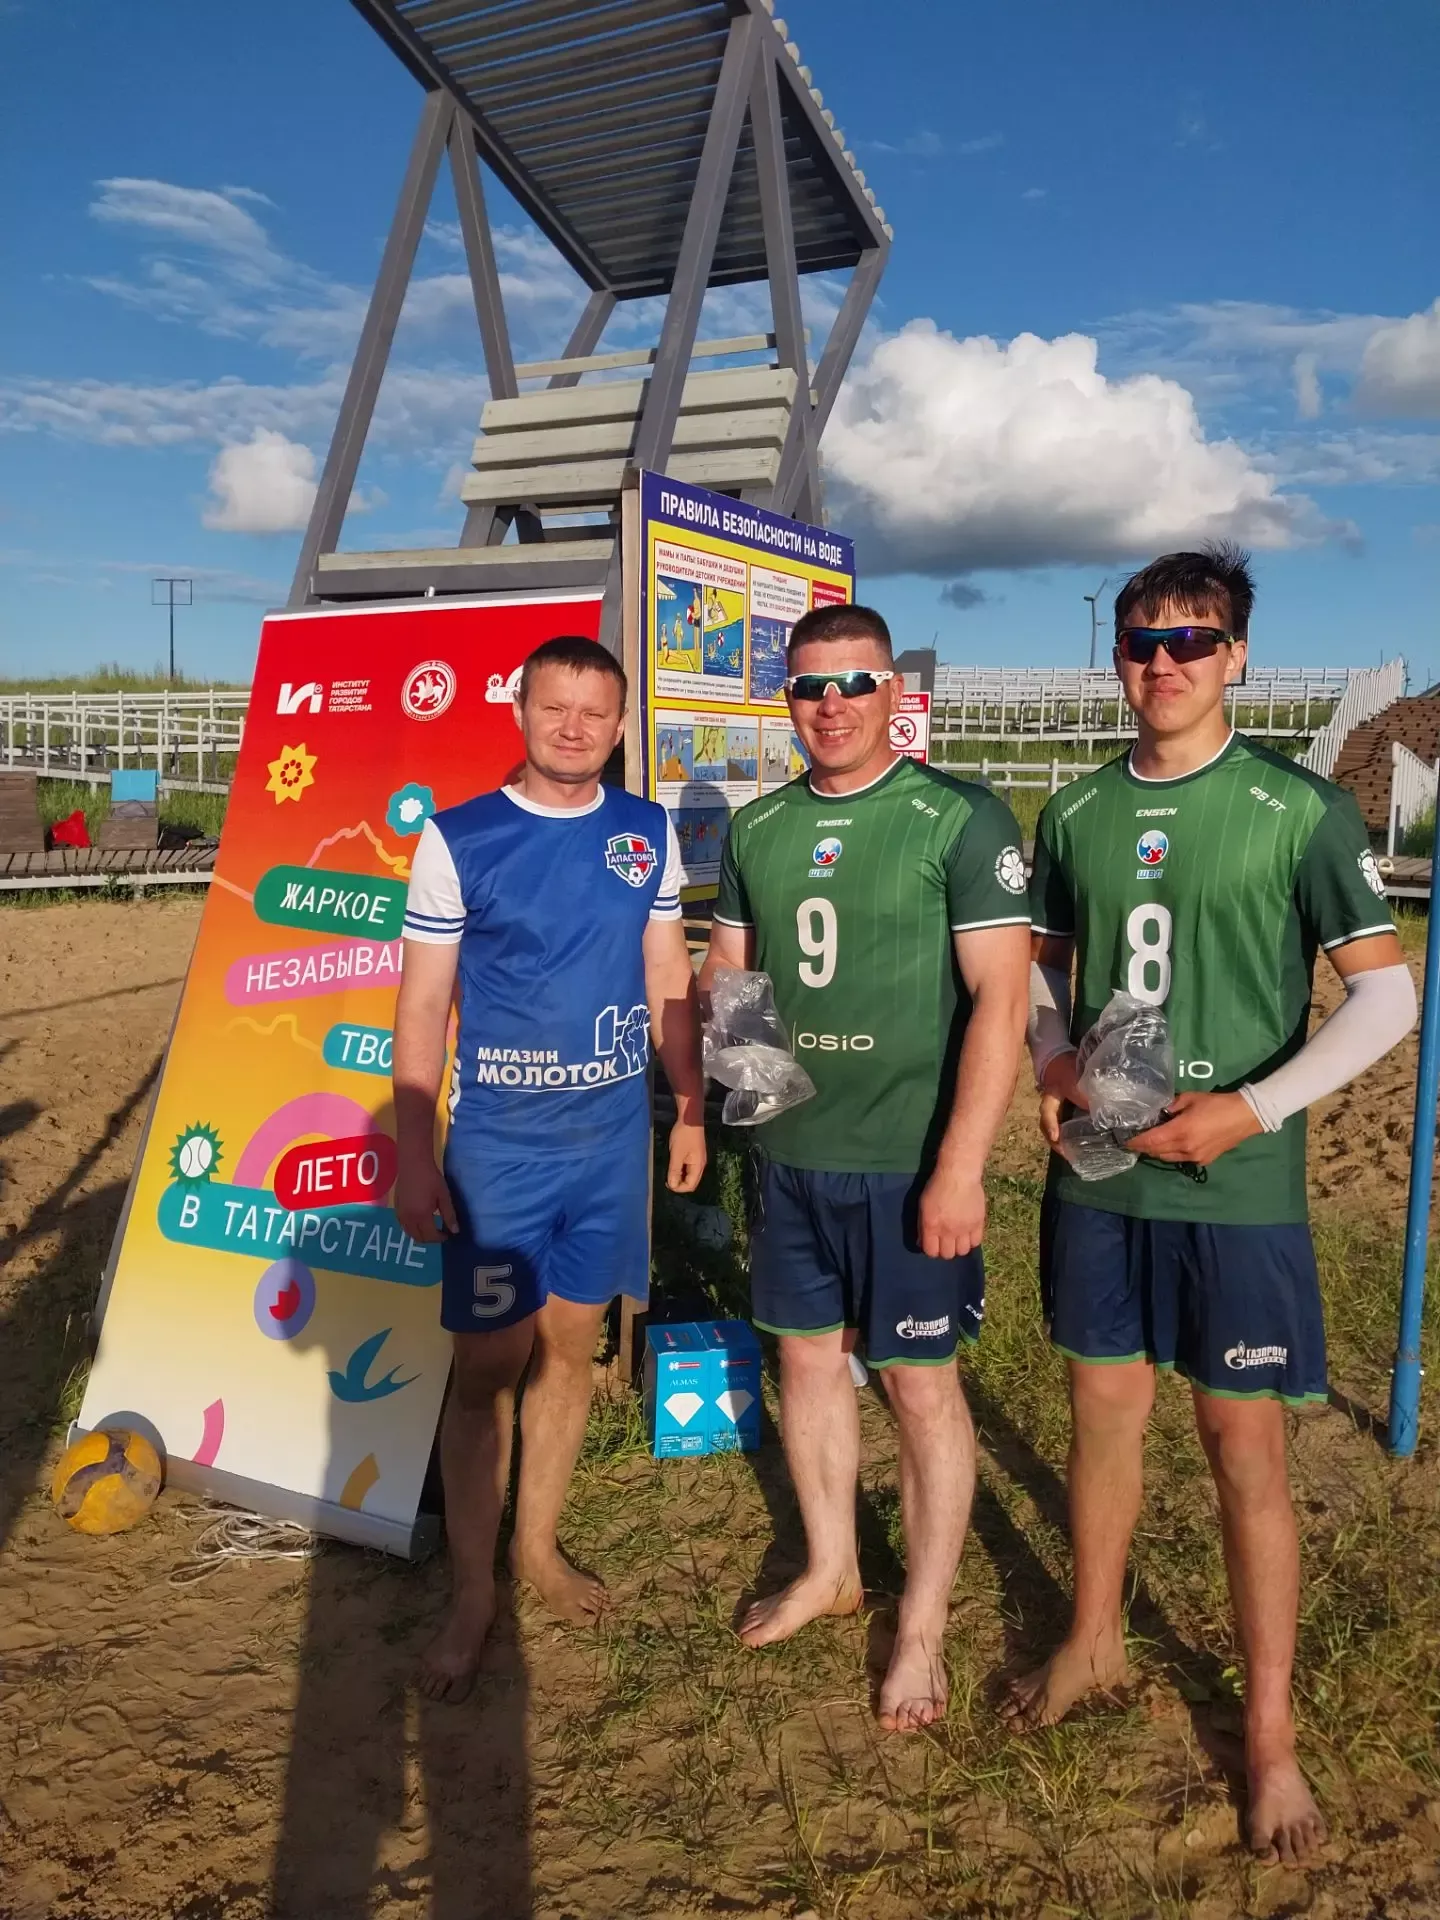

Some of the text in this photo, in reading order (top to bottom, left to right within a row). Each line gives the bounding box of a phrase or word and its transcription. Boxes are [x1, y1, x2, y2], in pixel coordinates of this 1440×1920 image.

[661, 491, 843, 567] ПРАВИЛА БЕЗОПАСНОСТИ НА ВОДЕ
[656, 561, 695, 576] РУКОВОДИТЕЛИ
[331, 680, 371, 689] ИНСТИТУТ
[330, 688, 368, 697] РАЗВИТИЯ
[328, 696, 363, 705] ГОРОДОВ
[327, 704, 373, 713] ТАТАРСТАНА
[1136, 807, 1178, 818] ENSEN
[816, 818, 853, 828] ENSEN
[610, 853, 653, 865] АПАСТОВО
[808, 868, 835, 878] ШВЛ
[1136, 869, 1164, 879] ШВЛ
[280, 882, 391, 924] ЖАРКОЕ
[796, 897, 838, 988] 9
[1127, 903, 1173, 1007] 8
[246, 943, 404, 993] НЕЗАБЫВА
[341, 1030, 393, 1069] ТВО
[477, 1047, 559, 1064] МАГАЗИН
[477, 1057, 618, 1087] МОЛОТОК
[292, 1150, 379, 1195] ЛЕТО
[179, 1194, 427, 1269] В ТАТАРСТАНЕ
[472, 1263, 516, 1318] 5
[915, 1315, 949, 1330] ГАЗПРОМ
[1246, 1346, 1288, 1359] ГАЗПРОМ
[669, 1378, 699, 1387] ALMAS
